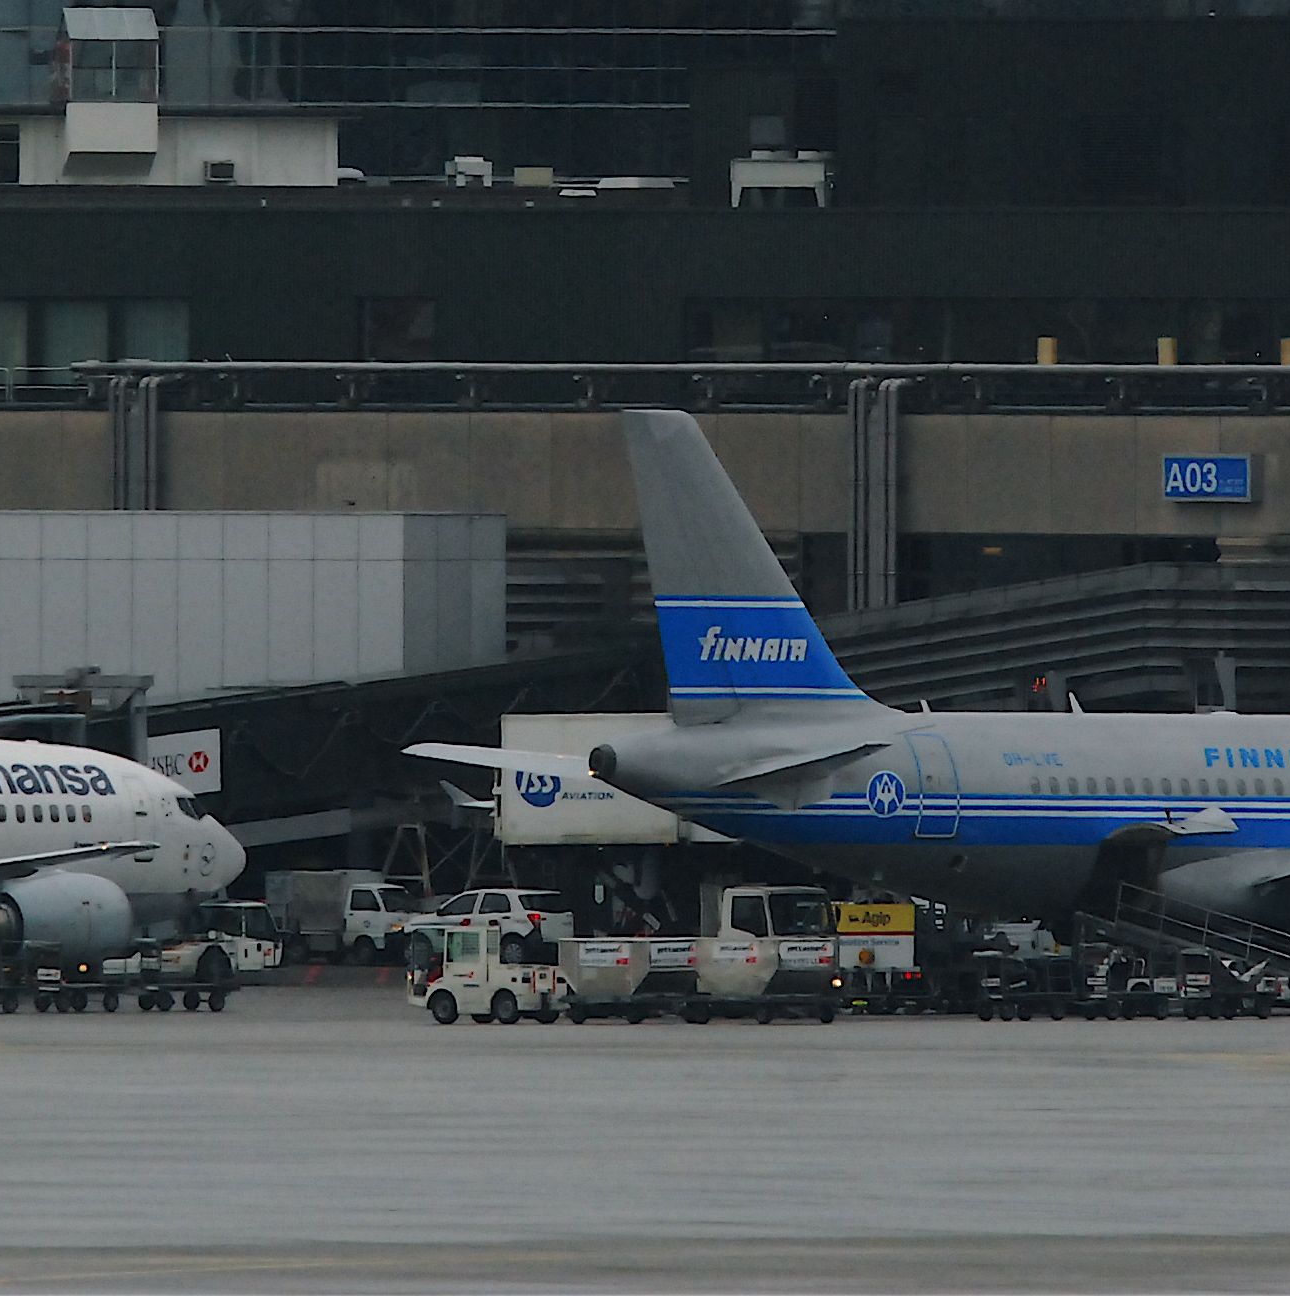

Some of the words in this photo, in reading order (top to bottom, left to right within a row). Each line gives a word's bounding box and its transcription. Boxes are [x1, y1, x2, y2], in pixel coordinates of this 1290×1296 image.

[1165, 462, 1218, 493] A03
[561, 791, 615, 800] AVIATION
[861, 911, 891, 927] Agip
